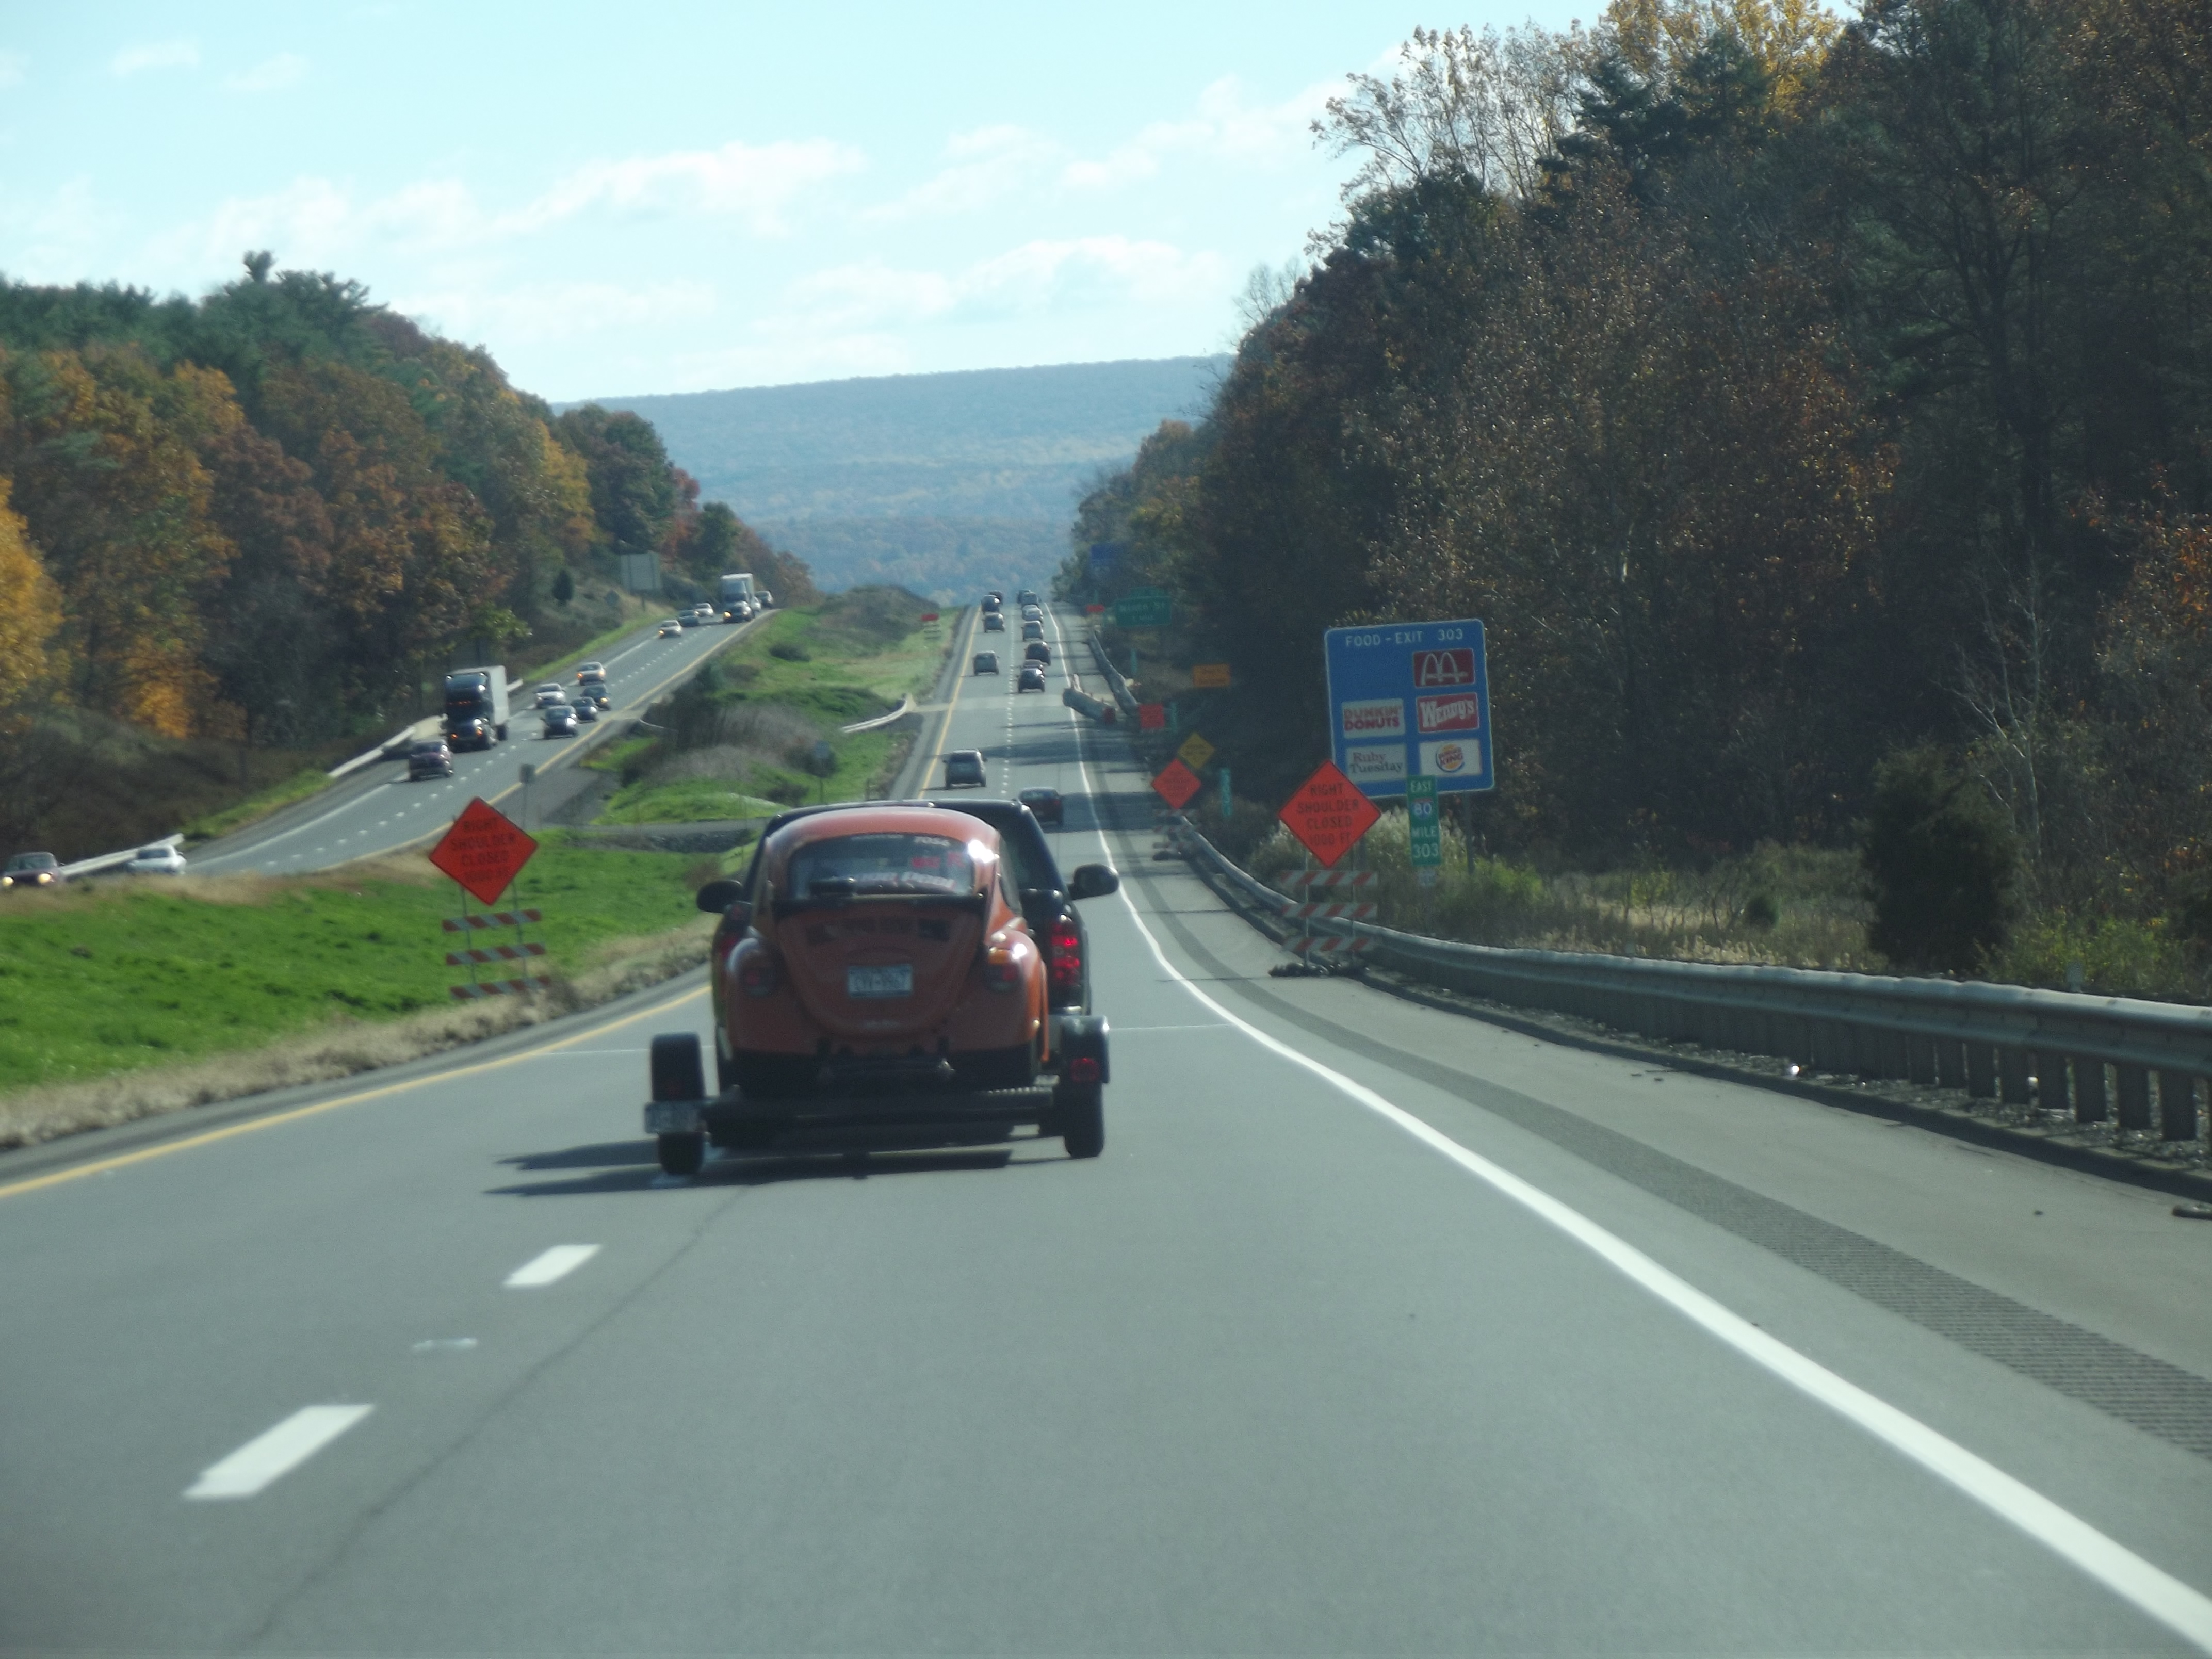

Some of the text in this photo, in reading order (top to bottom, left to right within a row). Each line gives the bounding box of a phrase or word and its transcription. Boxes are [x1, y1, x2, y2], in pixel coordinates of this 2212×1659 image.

[1345, 633, 1380, 646] FOOD
[1395, 631, 1423, 644] EXIT
[1438, 628, 1463, 640] 303
[1344, 715, 1400, 731] DONUTS
[1353, 752, 1386, 764] Ruby
[1349, 762, 1404, 773] Tuesday
[1310, 782, 1343, 796] RIGHT
[1411, 780, 1432, 793] EAST
[1297, 799, 1359, 814] SHOULDER
[1414, 803, 1432, 815] 80
[1307, 815, 1352, 830] CLOSED
[1411, 826, 1437, 838] MILE
[1412, 843, 1439, 858] 303
